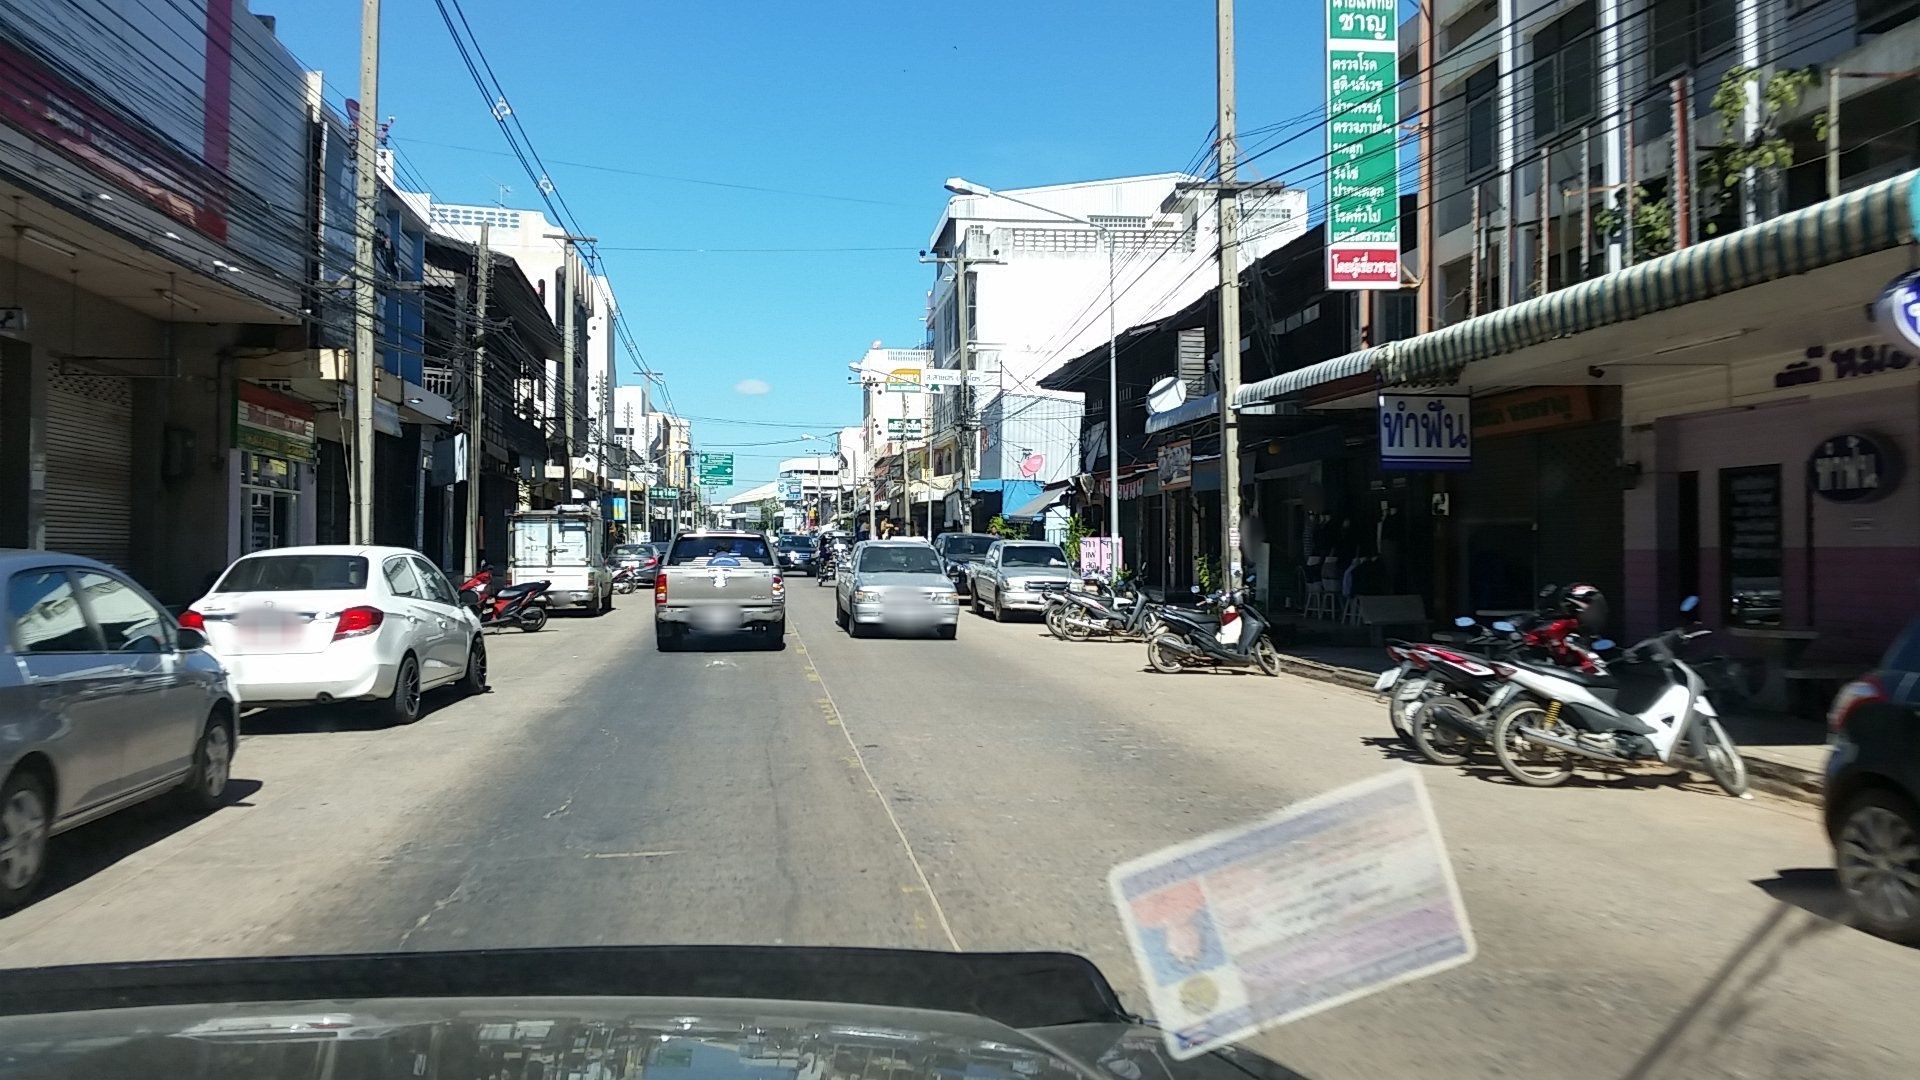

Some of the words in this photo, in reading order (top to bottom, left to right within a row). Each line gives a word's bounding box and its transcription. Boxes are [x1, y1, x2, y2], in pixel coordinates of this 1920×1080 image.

[1339, 13, 1387, 40] ชาญ
[1332, 52, 1378, 71] ตรวจโรค
[1383, 400, 1468, 448] ทำฟัน
